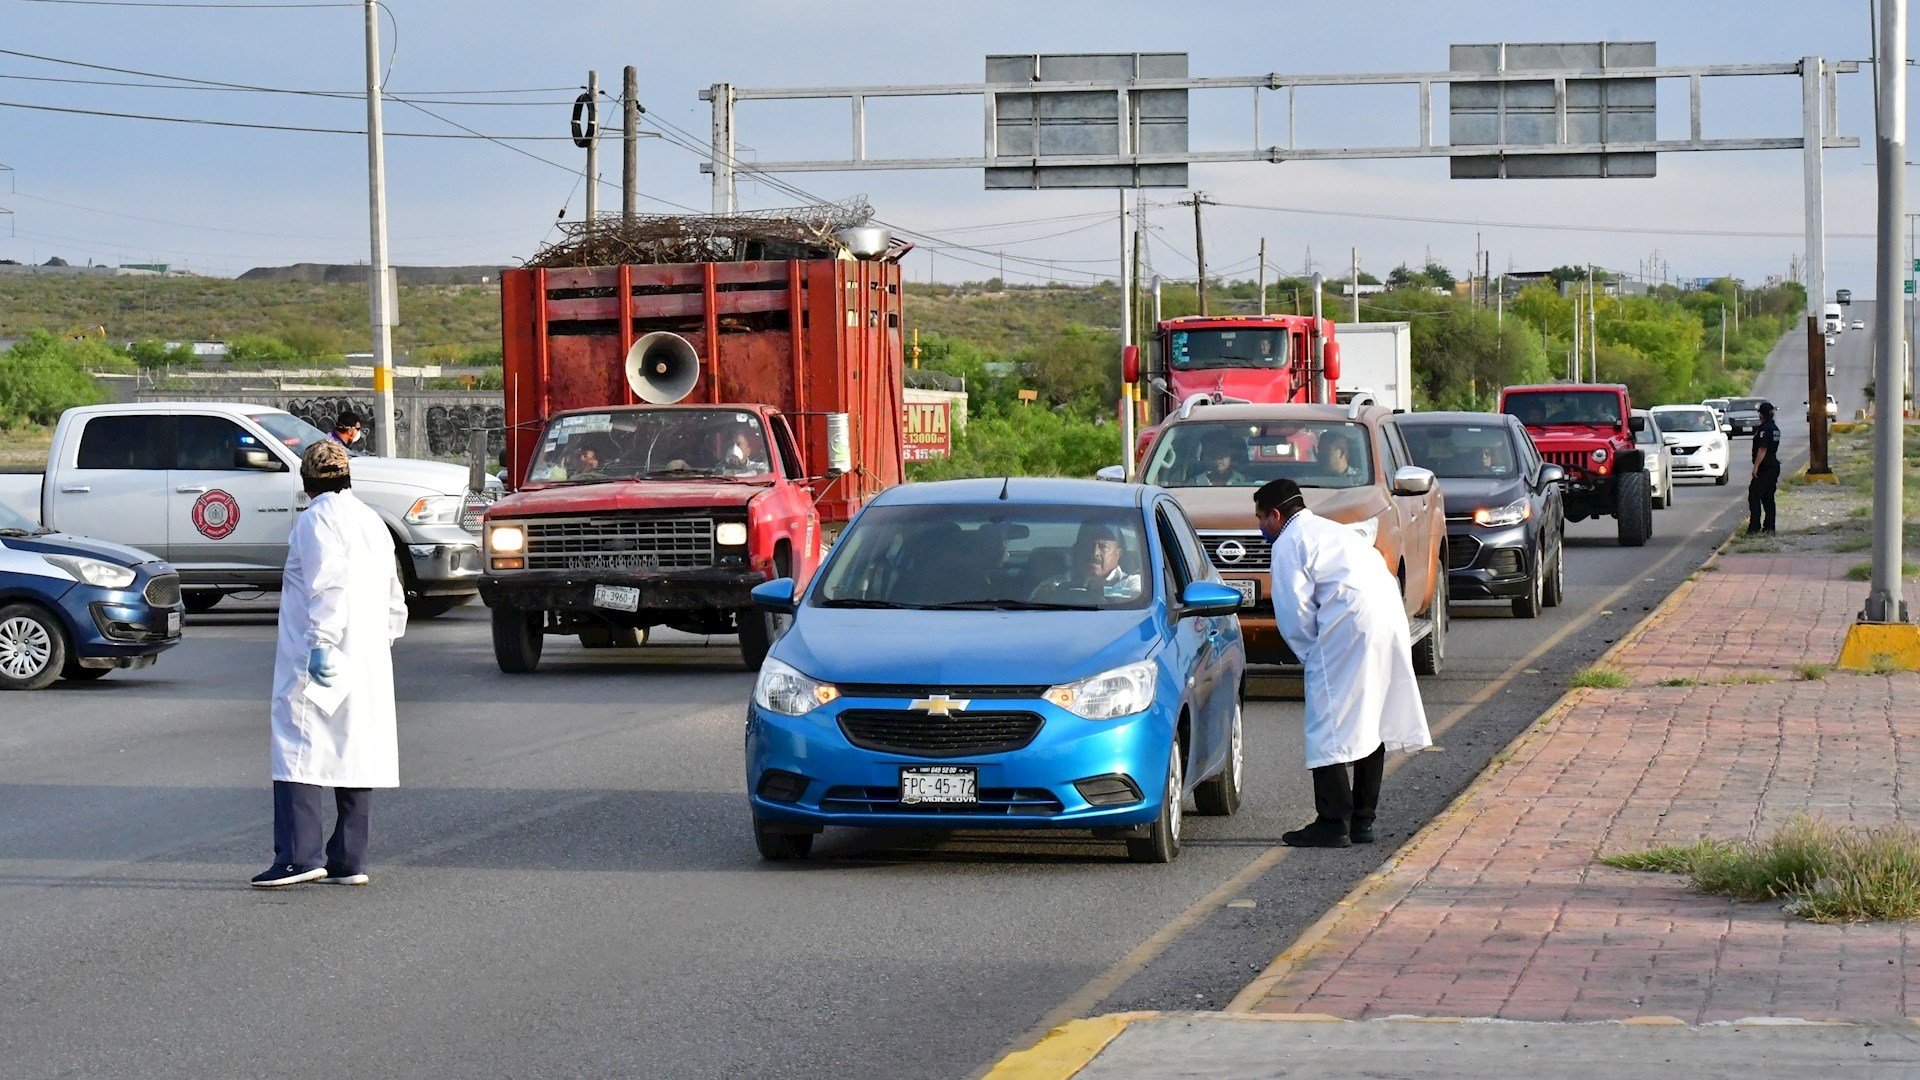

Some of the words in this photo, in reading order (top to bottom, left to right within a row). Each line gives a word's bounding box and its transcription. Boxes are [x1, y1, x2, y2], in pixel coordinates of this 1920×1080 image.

[597, 589, 637, 606] ER-3960-A
[1239, 588, 1253, 599] 28
[903, 777, 975, 794] FPC-45-72
